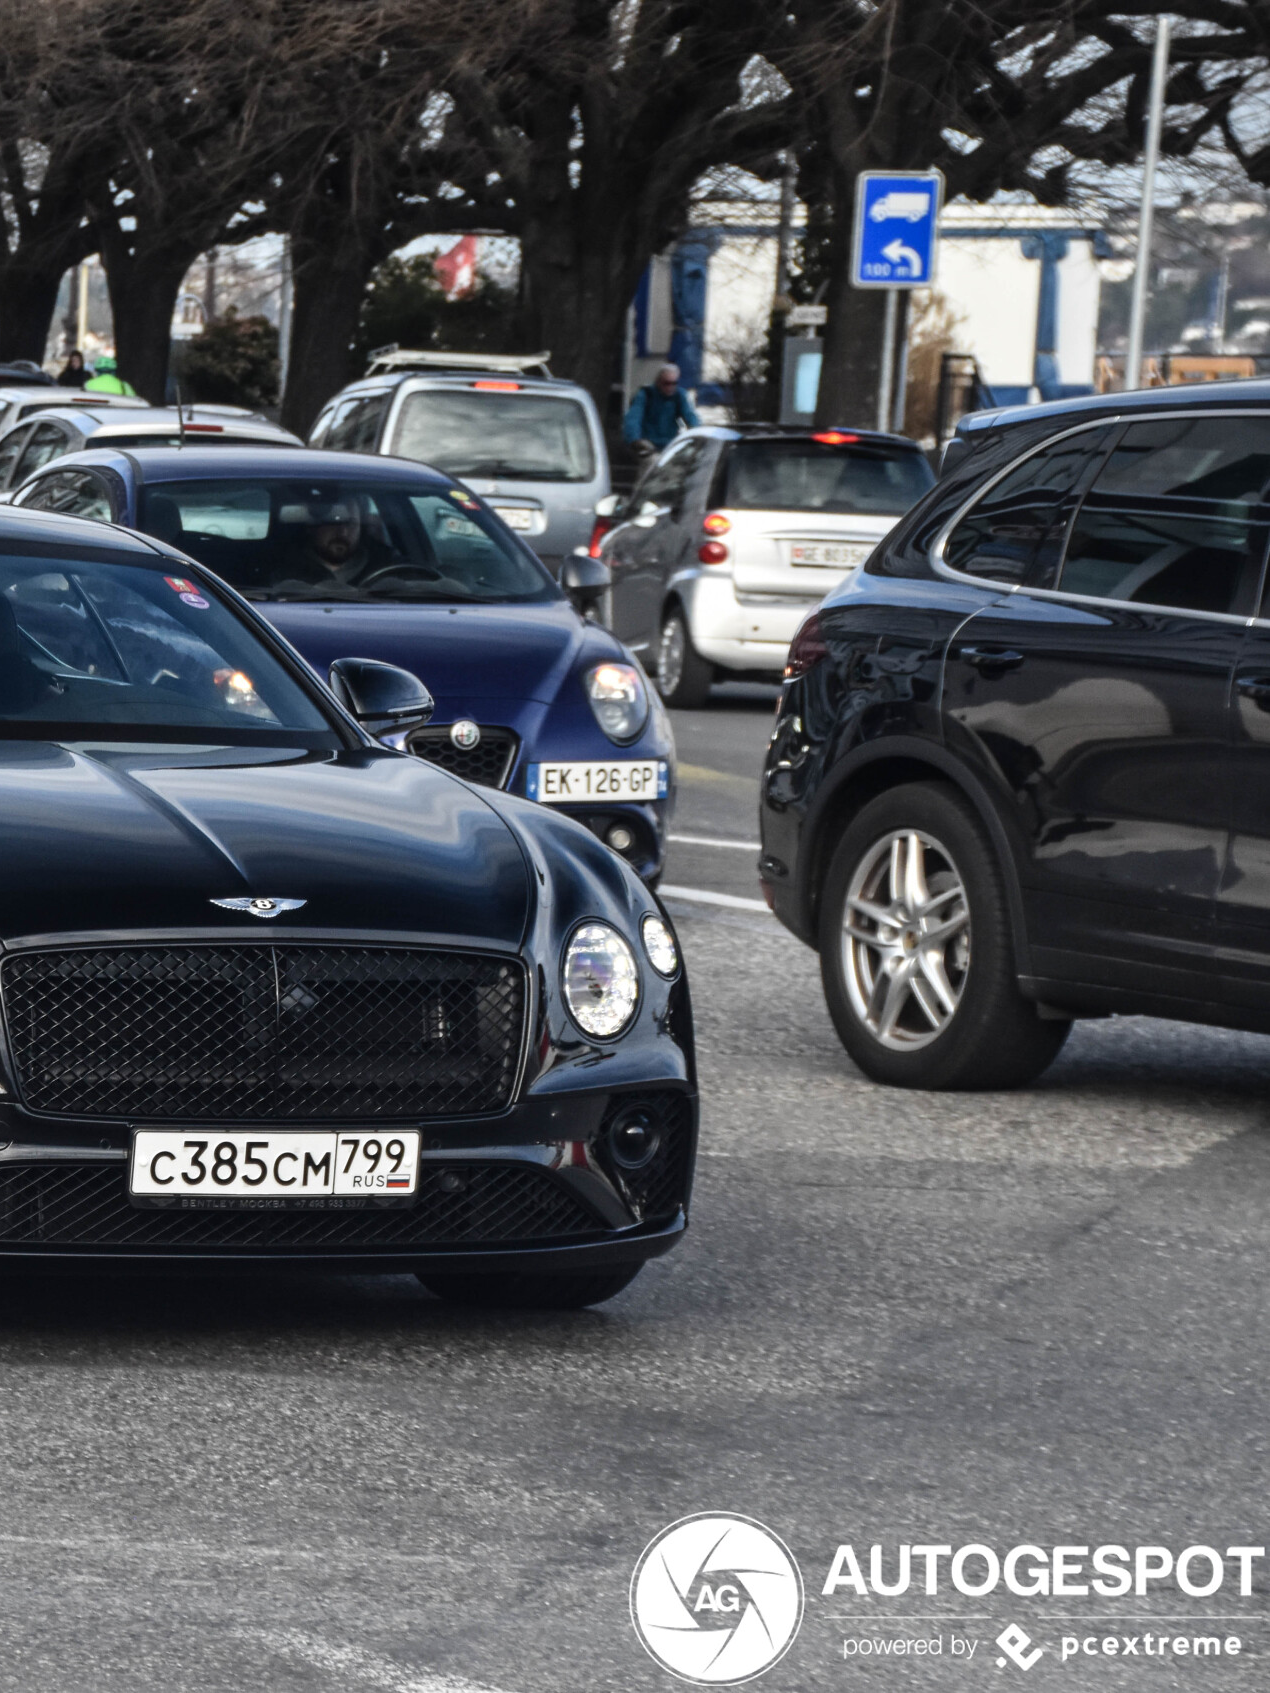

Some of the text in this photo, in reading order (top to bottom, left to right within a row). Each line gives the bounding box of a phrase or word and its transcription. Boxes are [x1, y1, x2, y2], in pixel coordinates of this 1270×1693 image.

[341, 1139, 405, 1173] 799
[353, 1175, 385, 1188] RUS
[181, 1199, 235, 1208] BENTLEY
